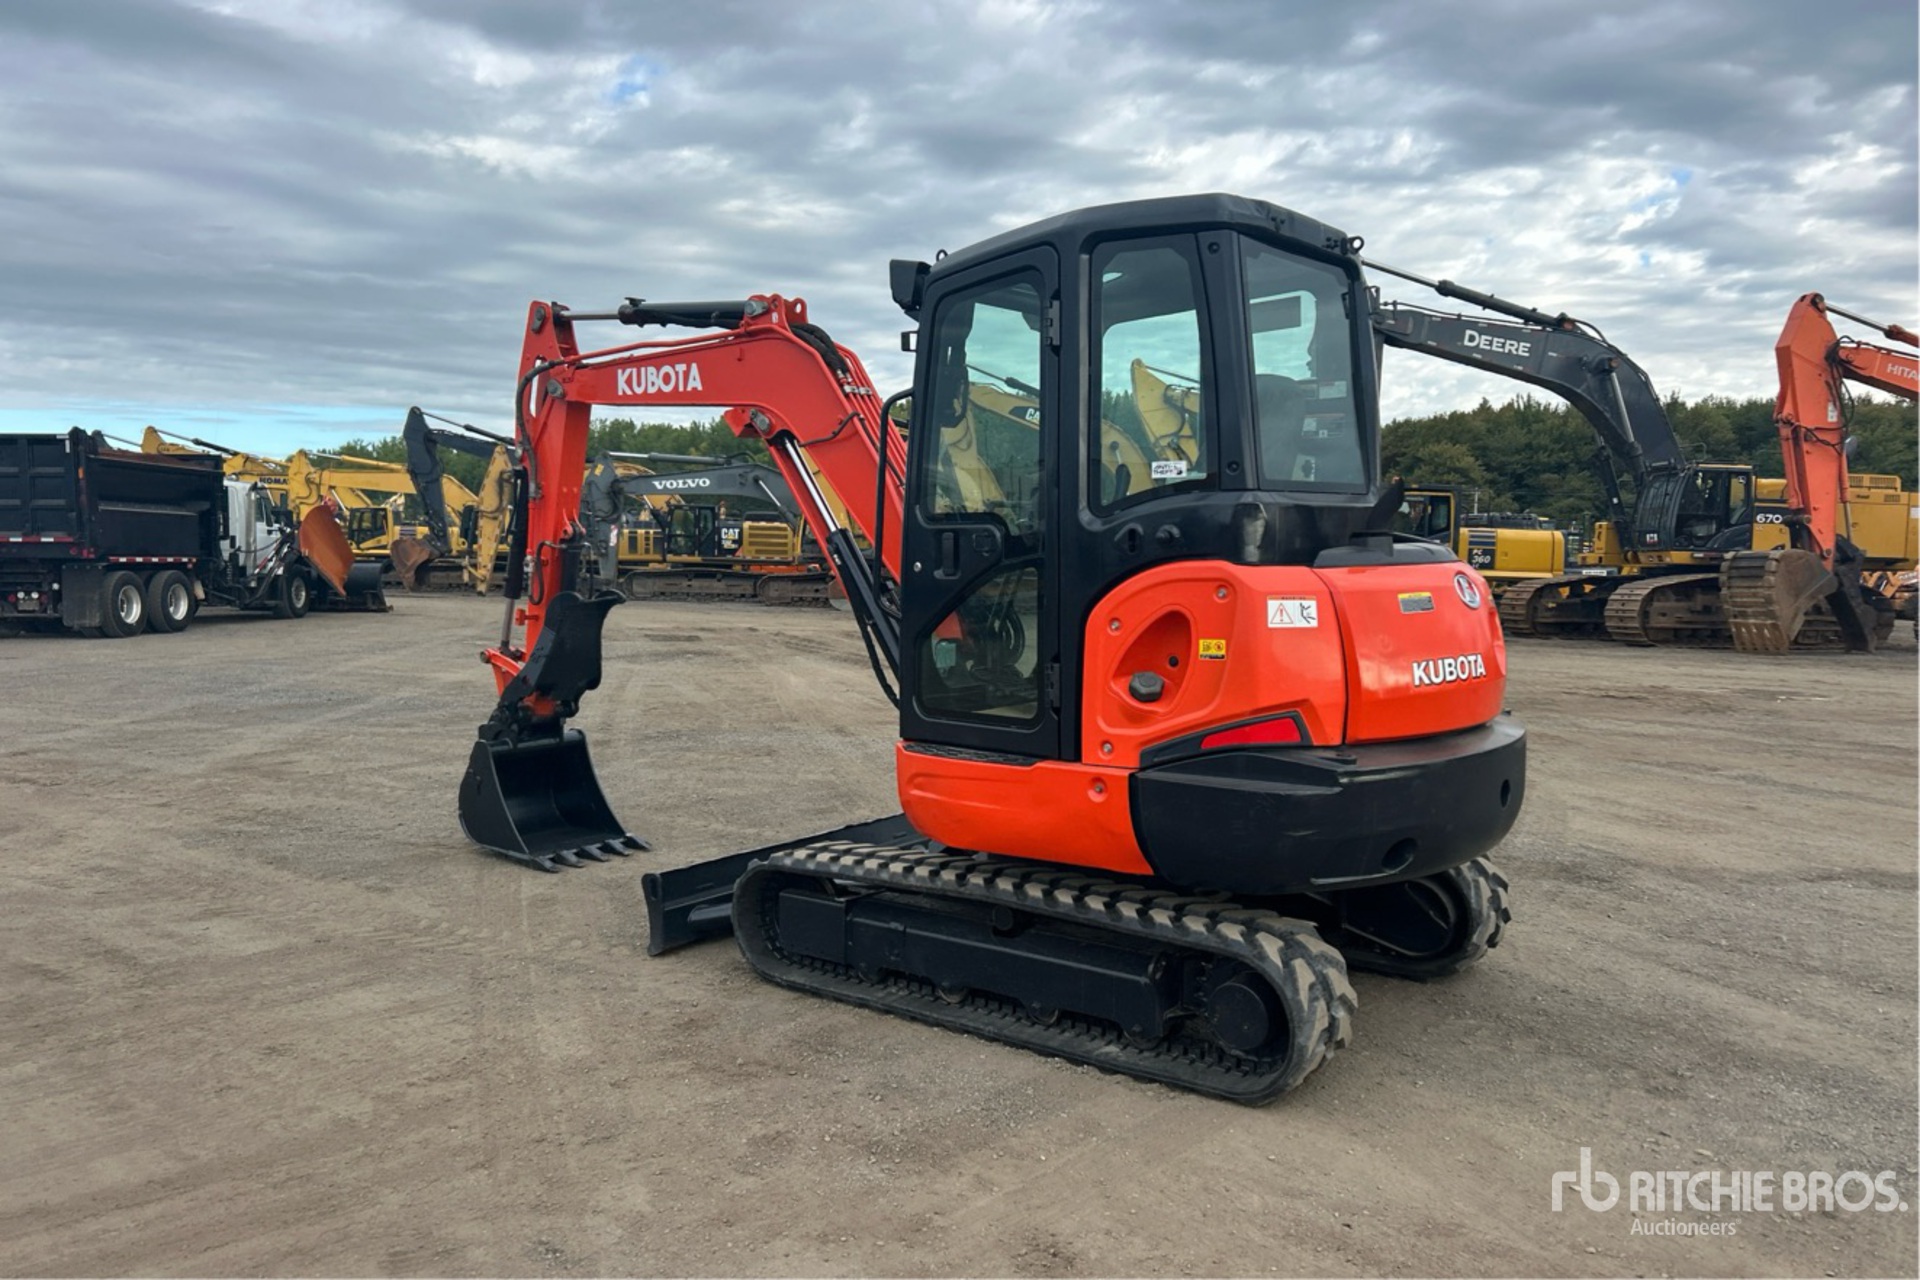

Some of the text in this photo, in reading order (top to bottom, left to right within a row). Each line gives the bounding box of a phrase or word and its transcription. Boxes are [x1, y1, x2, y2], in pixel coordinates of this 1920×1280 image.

[1463, 329, 1532, 357] DEERE
[617, 362, 703, 395] KUBOTA
[652, 477, 711, 490] VOLVO
[1756, 513, 1783, 524] 670
[720, 527, 740, 539] CAT
[1471, 555, 1492, 564] 360
[1411, 653, 1487, 687] KUBOTA
